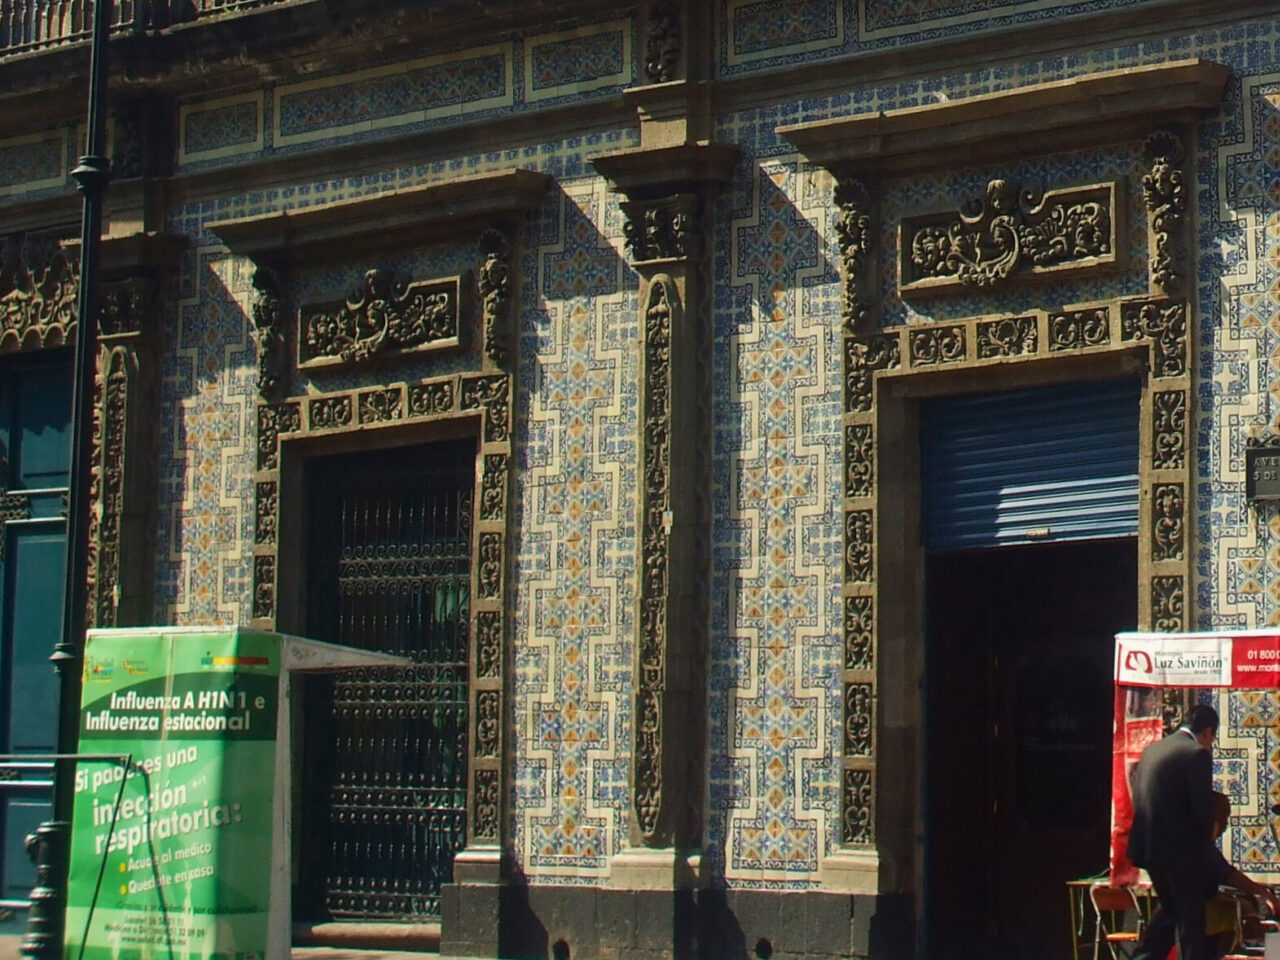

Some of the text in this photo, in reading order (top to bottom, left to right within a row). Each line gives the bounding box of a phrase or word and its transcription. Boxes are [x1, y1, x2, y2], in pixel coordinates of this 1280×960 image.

[1253, 471, 1260, 480] 5
[1264, 471, 1278, 480] DE
[1155, 655, 1223, 669] Luz Saviñón
[1247, 650, 1257, 659] 01
[1260, 650, 1275, 659] 800
[110, 690, 180, 710] Influenza
[183, 691, 195, 709] A
[254, 695, 266, 709] e
[86, 710, 250, 730] Influenza estacional
[75, 767, 88, 793] Si
[166, 745, 198, 768] una
[161, 848, 172, 864] al
[174, 872, 188, 884] en
[189, 865, 214, 881] casa
